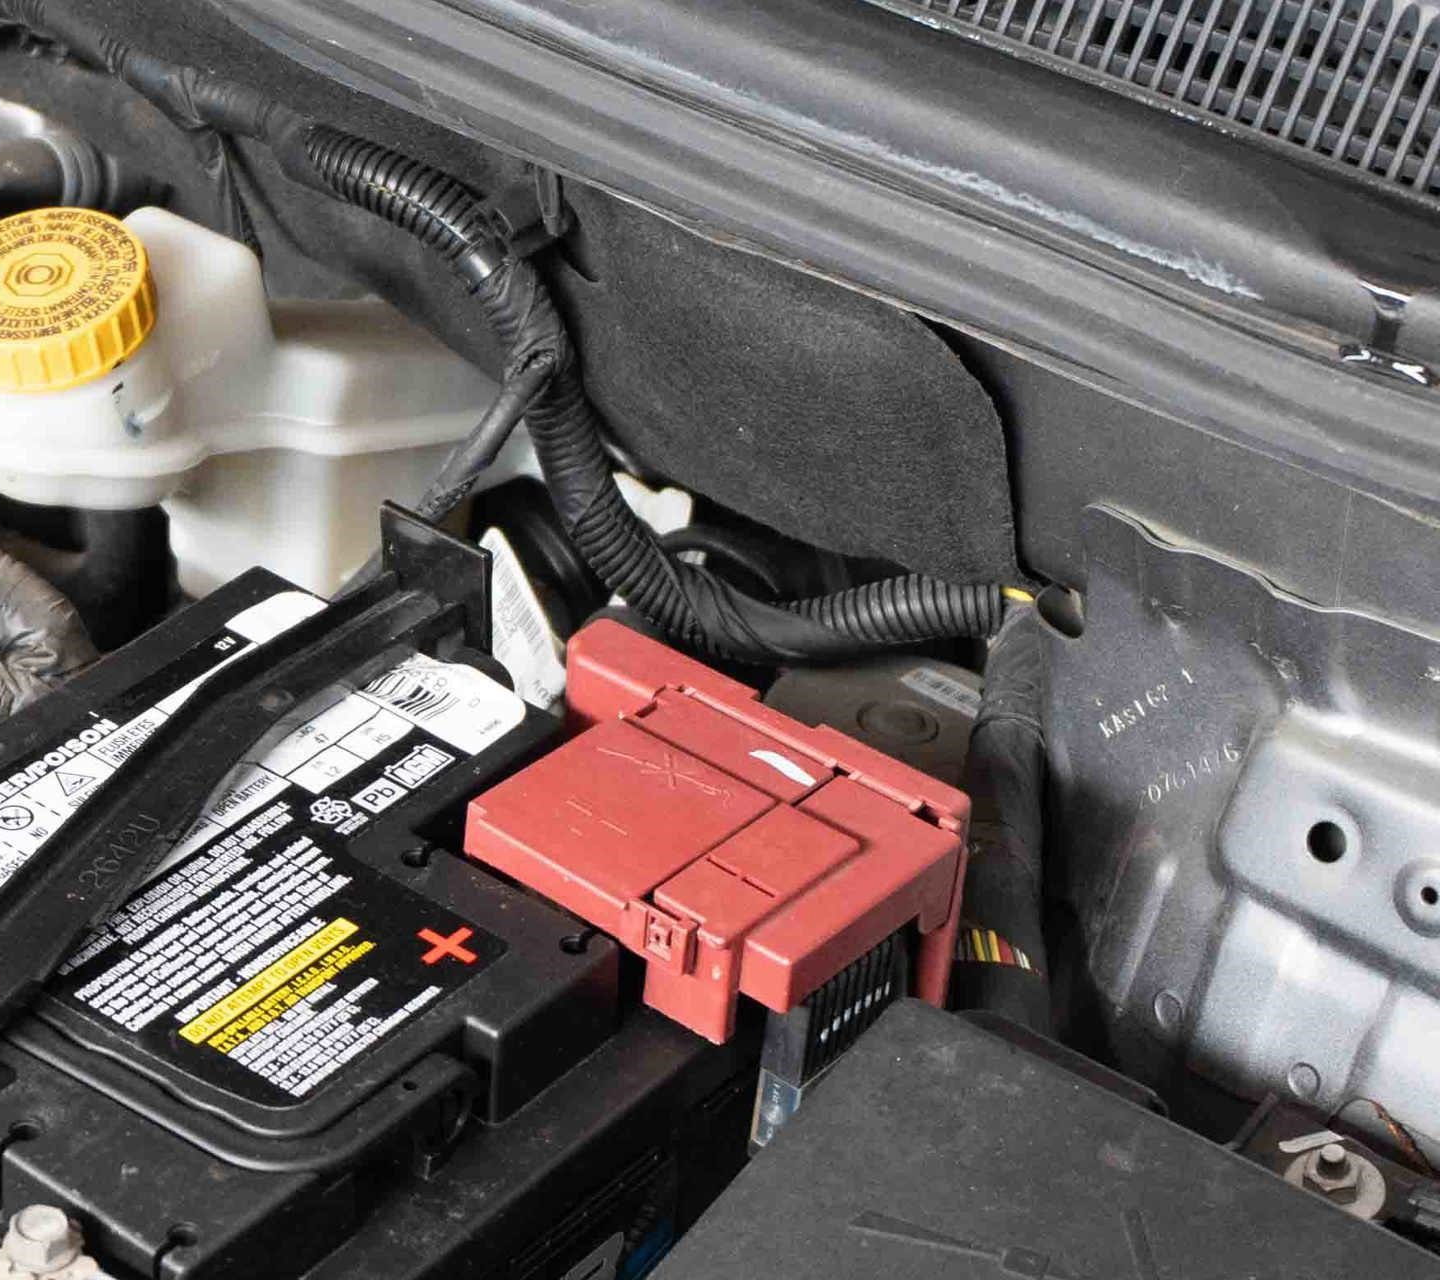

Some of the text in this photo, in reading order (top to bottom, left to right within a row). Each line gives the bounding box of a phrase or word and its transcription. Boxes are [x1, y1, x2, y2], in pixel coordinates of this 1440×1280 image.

[97, 717, 156, 756] FLUSH EYES
[391, 747, 449, 786] AGM
[213, 774, 273, 817] OPEN BATTERY
[363, 787, 395, 806] Pb
[207, 845, 225, 856] DO
[219, 834, 240, 848] NOT
[114, 920, 136, 934] NOT
[121, 919, 159, 944] PROPER
[224, 976, 274, 1010] ATTEMPT
[282, 947, 315, 969] OPEN
